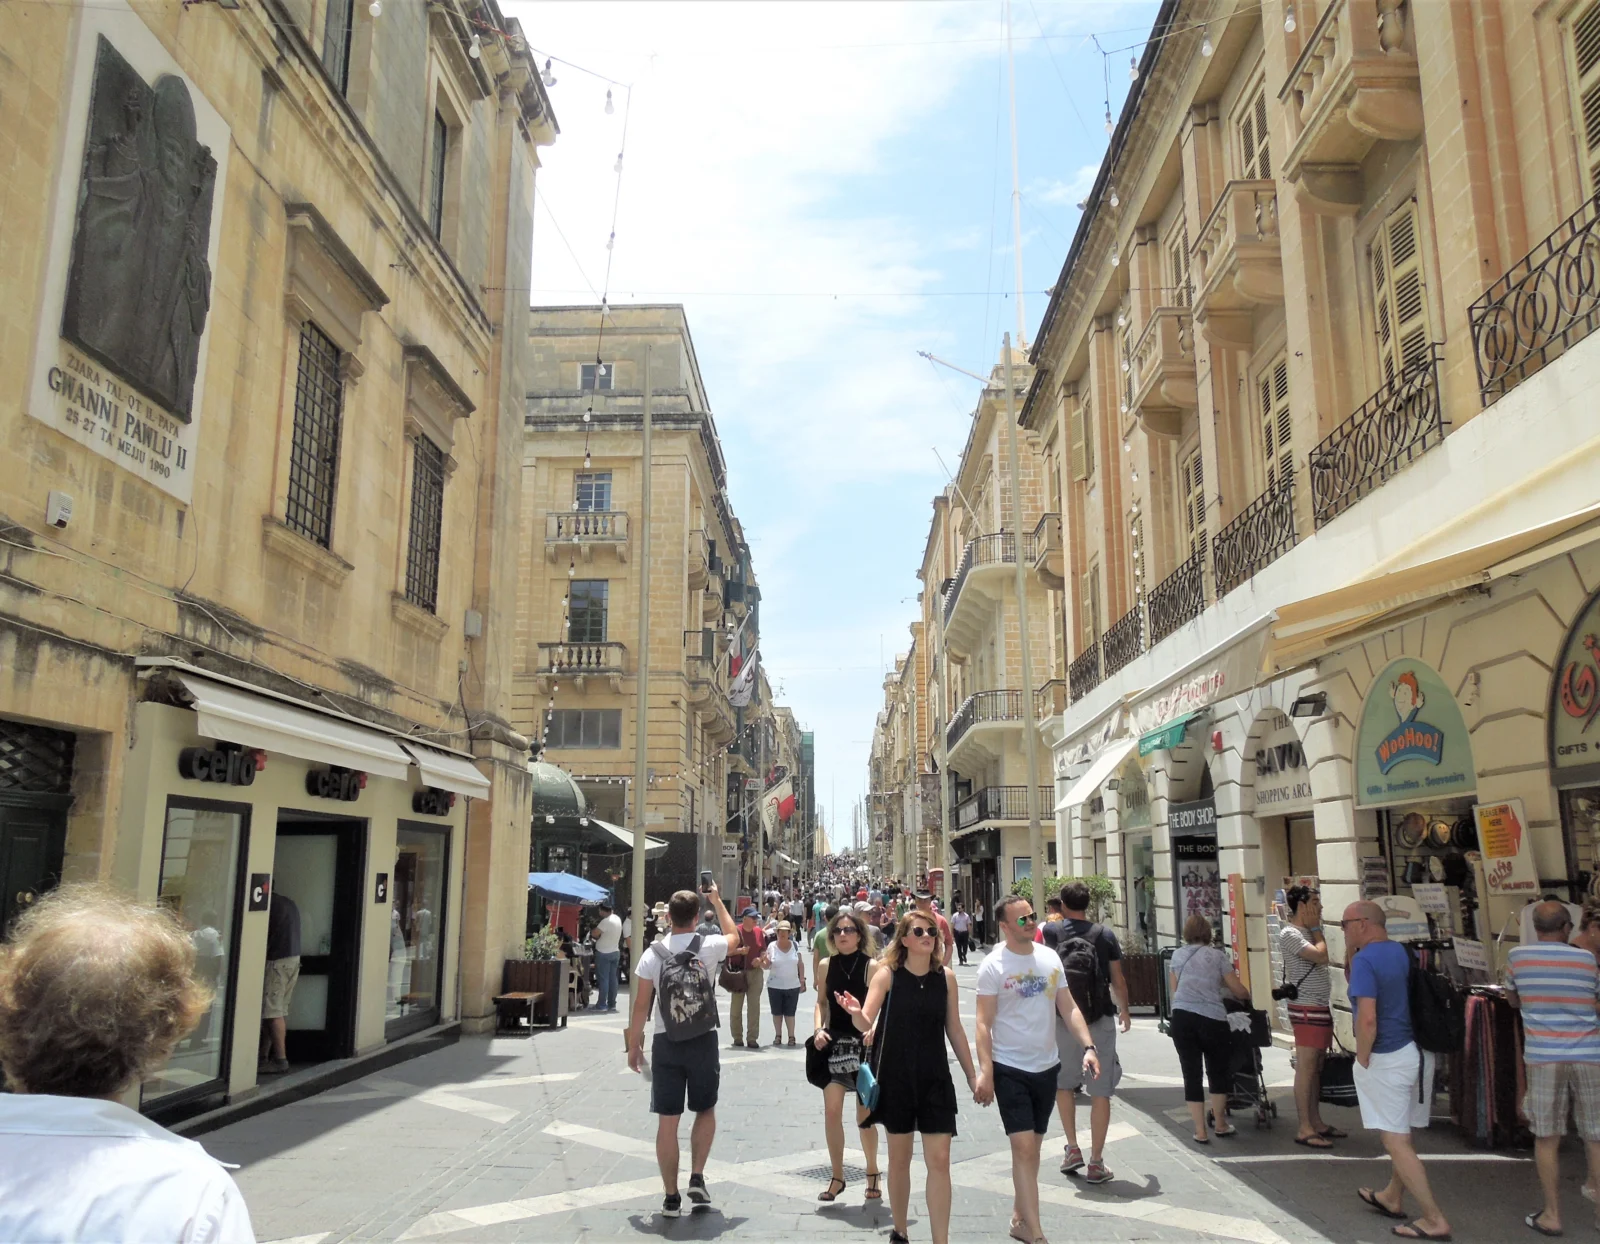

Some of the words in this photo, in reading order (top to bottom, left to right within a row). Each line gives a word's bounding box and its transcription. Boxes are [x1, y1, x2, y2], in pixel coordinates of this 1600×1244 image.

[124, 411, 173, 459] PAWLU
[175, 445, 188, 470] II
[117, 437, 147, 464] MEJJU
[150, 457, 172, 480] 1990
[1273, 714, 1290, 731] THE
[1557, 743, 1588, 756] GIFTS
[1256, 786, 1290, 805] SHOPPING
[1168, 812, 1180, 829] THE
[1180, 810, 1196, 828] BODY
[1479, 806, 1498, 819] PLEASE
[722, 845, 735, 853] BOV
[1177, 844, 1195, 853] THE
